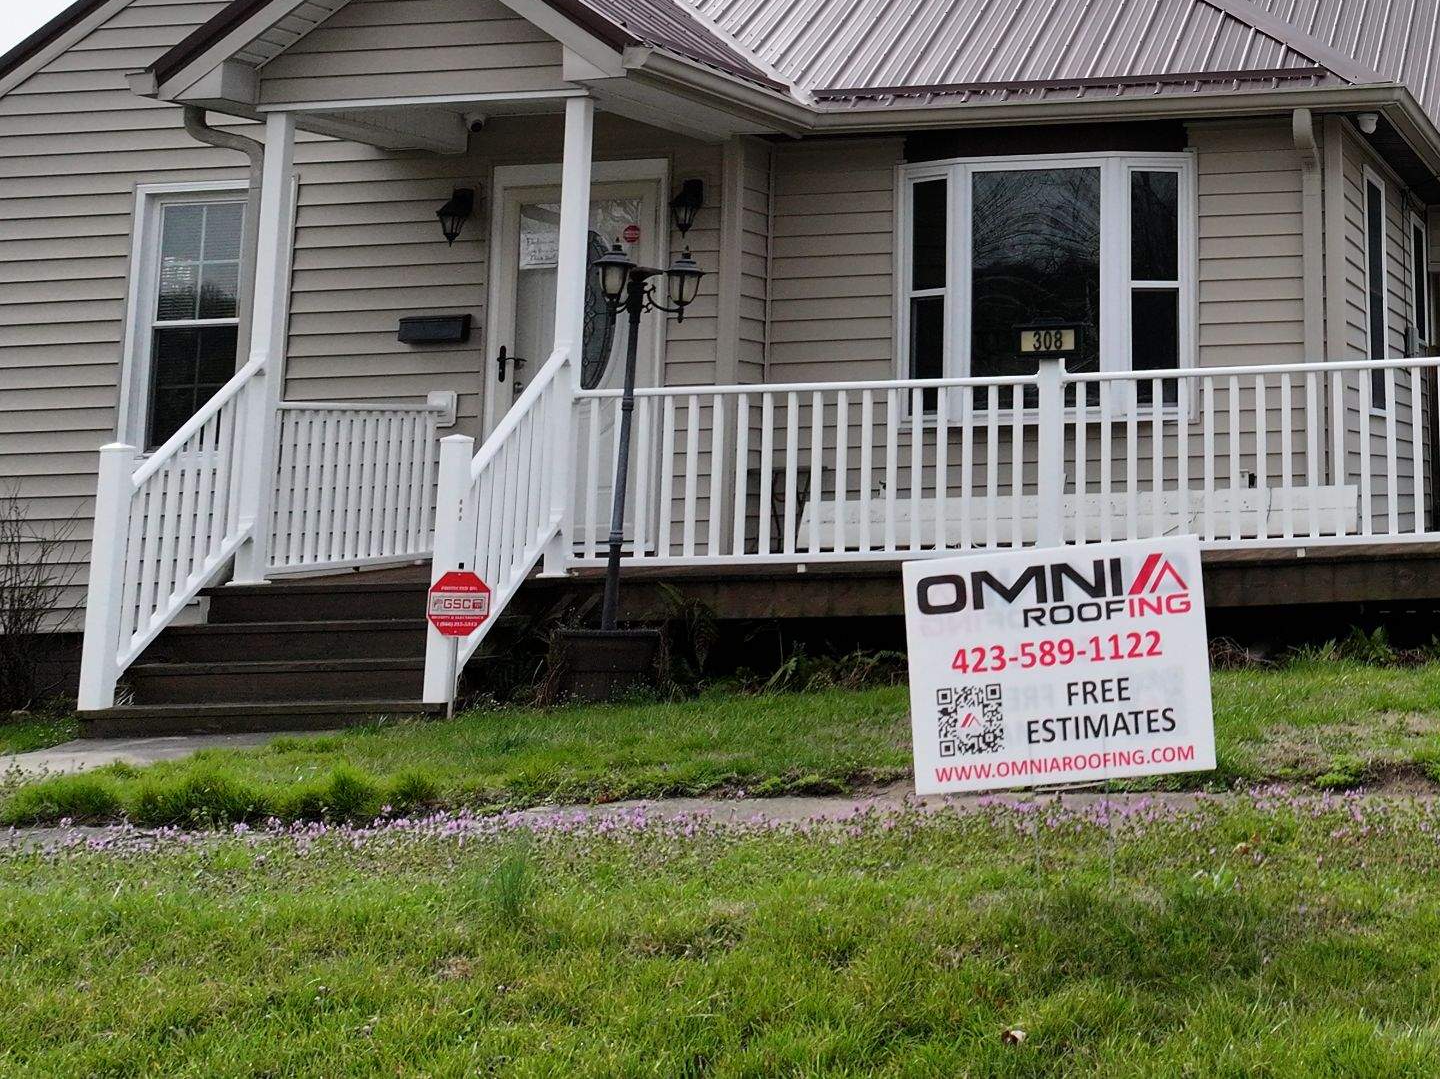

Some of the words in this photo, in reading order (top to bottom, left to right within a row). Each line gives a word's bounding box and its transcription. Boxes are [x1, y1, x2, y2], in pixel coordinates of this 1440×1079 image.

[1033, 330, 1063, 350] 308
[1023, 594, 1191, 628] ROOFING
[951, 630, 1163, 674] 423-589-1122
[1067, 677, 1131, 706] FREE
[1027, 708, 1176, 744] ESTIMATES
[935, 745, 1194, 782] WWW.OMNIAROOFING.COM
